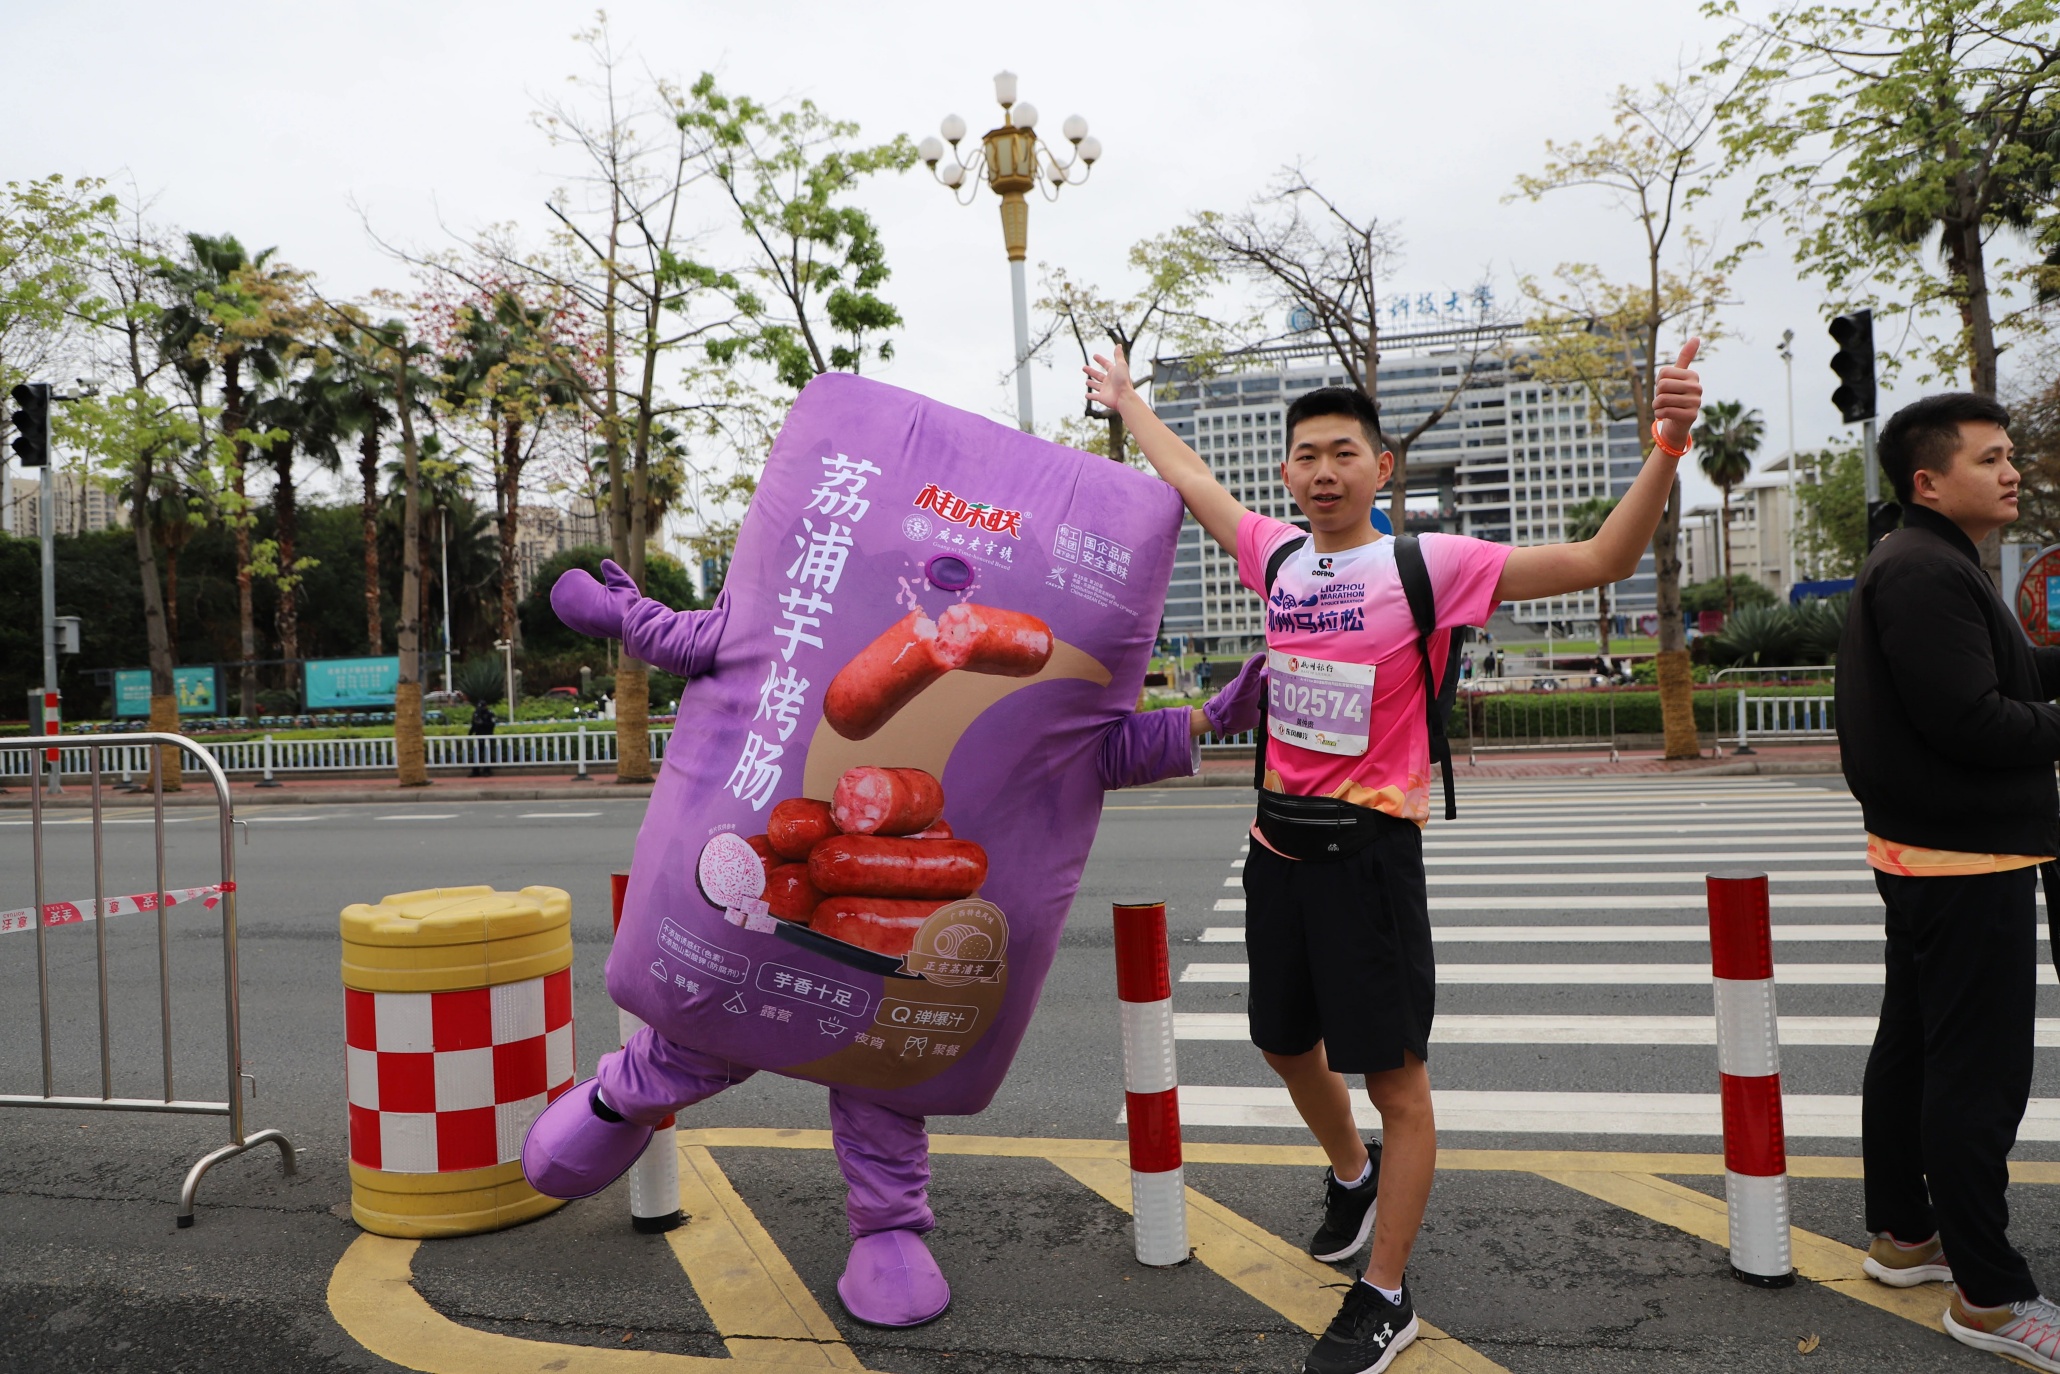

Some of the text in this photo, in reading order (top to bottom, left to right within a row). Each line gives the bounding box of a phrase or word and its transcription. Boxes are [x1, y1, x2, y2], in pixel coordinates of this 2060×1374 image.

[913, 483, 1022, 540] 桂味联
[1084, 536, 1132, 567] 国企品质
[1082, 550, 1128, 580] 安全美味
[1320, 583, 1365, 593] LIUZHOU
[1320, 591, 1364, 601] MARATHON
[724, 453, 881, 811] 荔浦芋烤肠
[1271, 677, 1363, 723] E 02574
[923, 961, 984, 976] 正宗荔浦芋
[673, 972, 700, 996] 早餐
[773, 971, 853, 1008] 芋香十足
[759, 1005, 793, 1024] 露营
[913, 1009, 965, 1028] 弹爆汁
[854, 1031, 885, 1050] 夜宵
[932, 1043, 960, 1058] 聚餐
